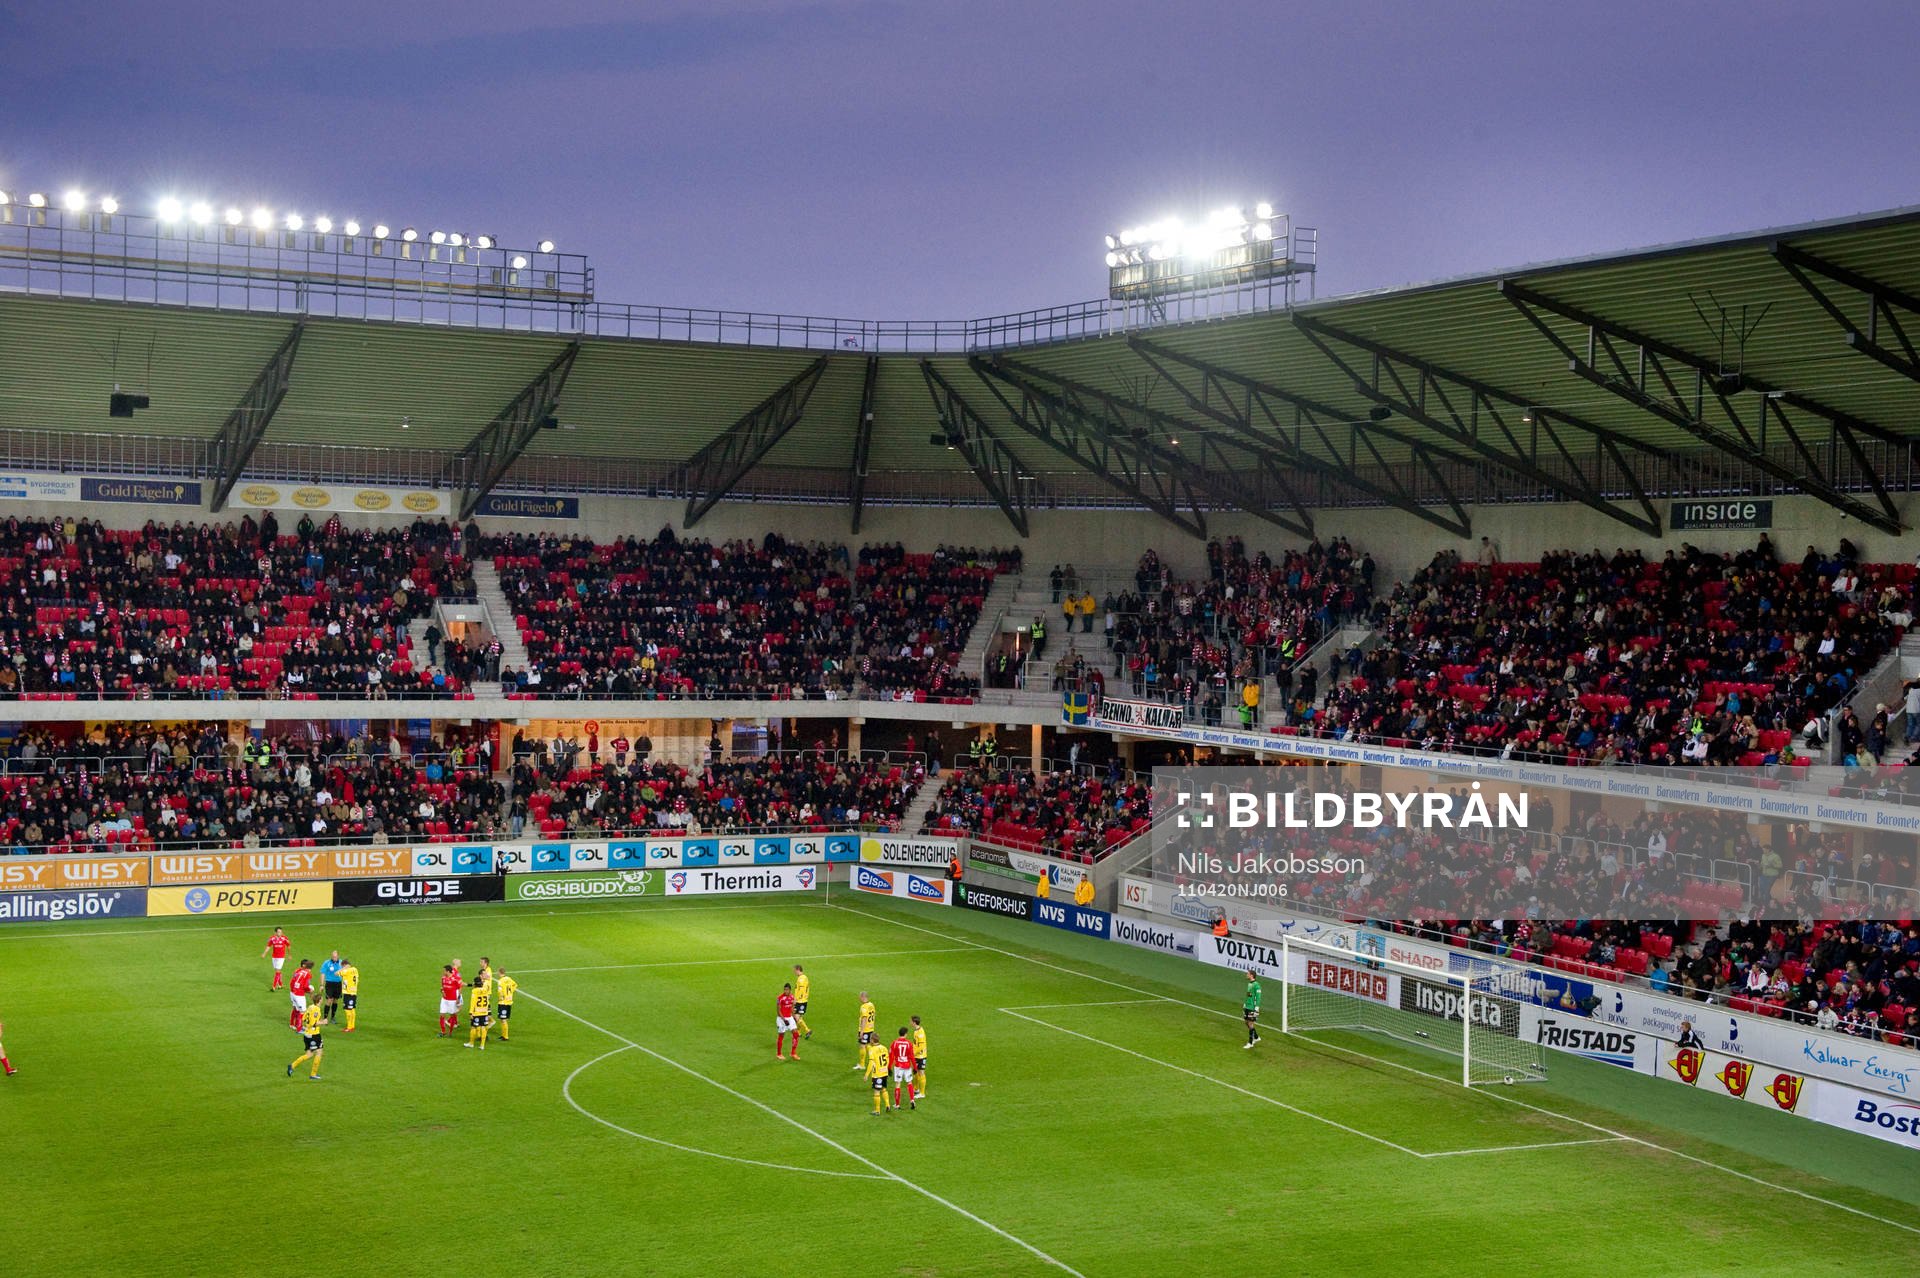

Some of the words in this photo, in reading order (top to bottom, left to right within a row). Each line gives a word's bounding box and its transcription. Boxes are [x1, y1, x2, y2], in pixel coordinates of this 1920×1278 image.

[98, 483, 130, 497] Guld
[134, 485, 174, 500] Fågeln
[491, 500, 517, 512] Guld
[520, 501, 555, 514] Fågeln
[1685, 502, 1757, 520] inside
[1296, 742, 1324, 754] Barometern
[1329, 746, 1358, 759] Barometern
[1363, 750, 1394, 764] Barometern
[1400, 755, 1432, 768] Barometern
[1438, 759, 1471, 773] Barometern
[1477, 763, 1512, 778] Barometern
[1519, 769, 1556, 784] Barometern
[1563, 774, 1601, 789] Barometern
[1608, 779, 1649, 796] Barometern
[1657, 785, 1699, 802] Barometern
[1707, 791, 1752, 808] Barometern
[1760, 798, 1808, 815] Barometern
[1817, 805, 1867, 823] Barometern
[249, 853, 319, 871] WISY
[335, 851, 402, 868] WISY
[884, 843, 956, 863] SOLENERGIHUS
[64, 862, 139, 880] WISY
[160, 857, 233, 874] WISY
[523, 881, 641, 897] CASHBUDDY.se
[701, 871, 782, 890] Thermia
[216, 889, 298, 908] POSTEN!
[968, 891, 1026, 915] EKEFORSHUS
[1126, 884, 1147, 904] KST
[1040, 904, 1065, 923] NVS
[1077, 912, 1103, 931] NVS
[1115, 920, 1174, 950] Volvokort
[1214, 937, 1280, 967] VOLVIA
[1391, 948, 1443, 970] SHARP
[1311, 965, 1385, 996] CRAMO
[476, 997, 488, 1007] 23
[1416, 982, 1501, 1027] Inspecta
[1608, 1013, 1628, 1025] BONG
[1652, 1006, 1682, 1021] envelope
[1683, 1014, 1697, 1023] and
[1642, 1017, 1675, 1033] packaging
[1537, 1019, 1636, 1054] FRISTADS
[898, 1045, 907, 1057] 17
[1721, 1040, 1744, 1055] BONG
[879, 1054, 888, 1066] 15
[1804, 1039, 1861, 1067] Kalmar
[1863, 1056, 1919, 1093] Energi
